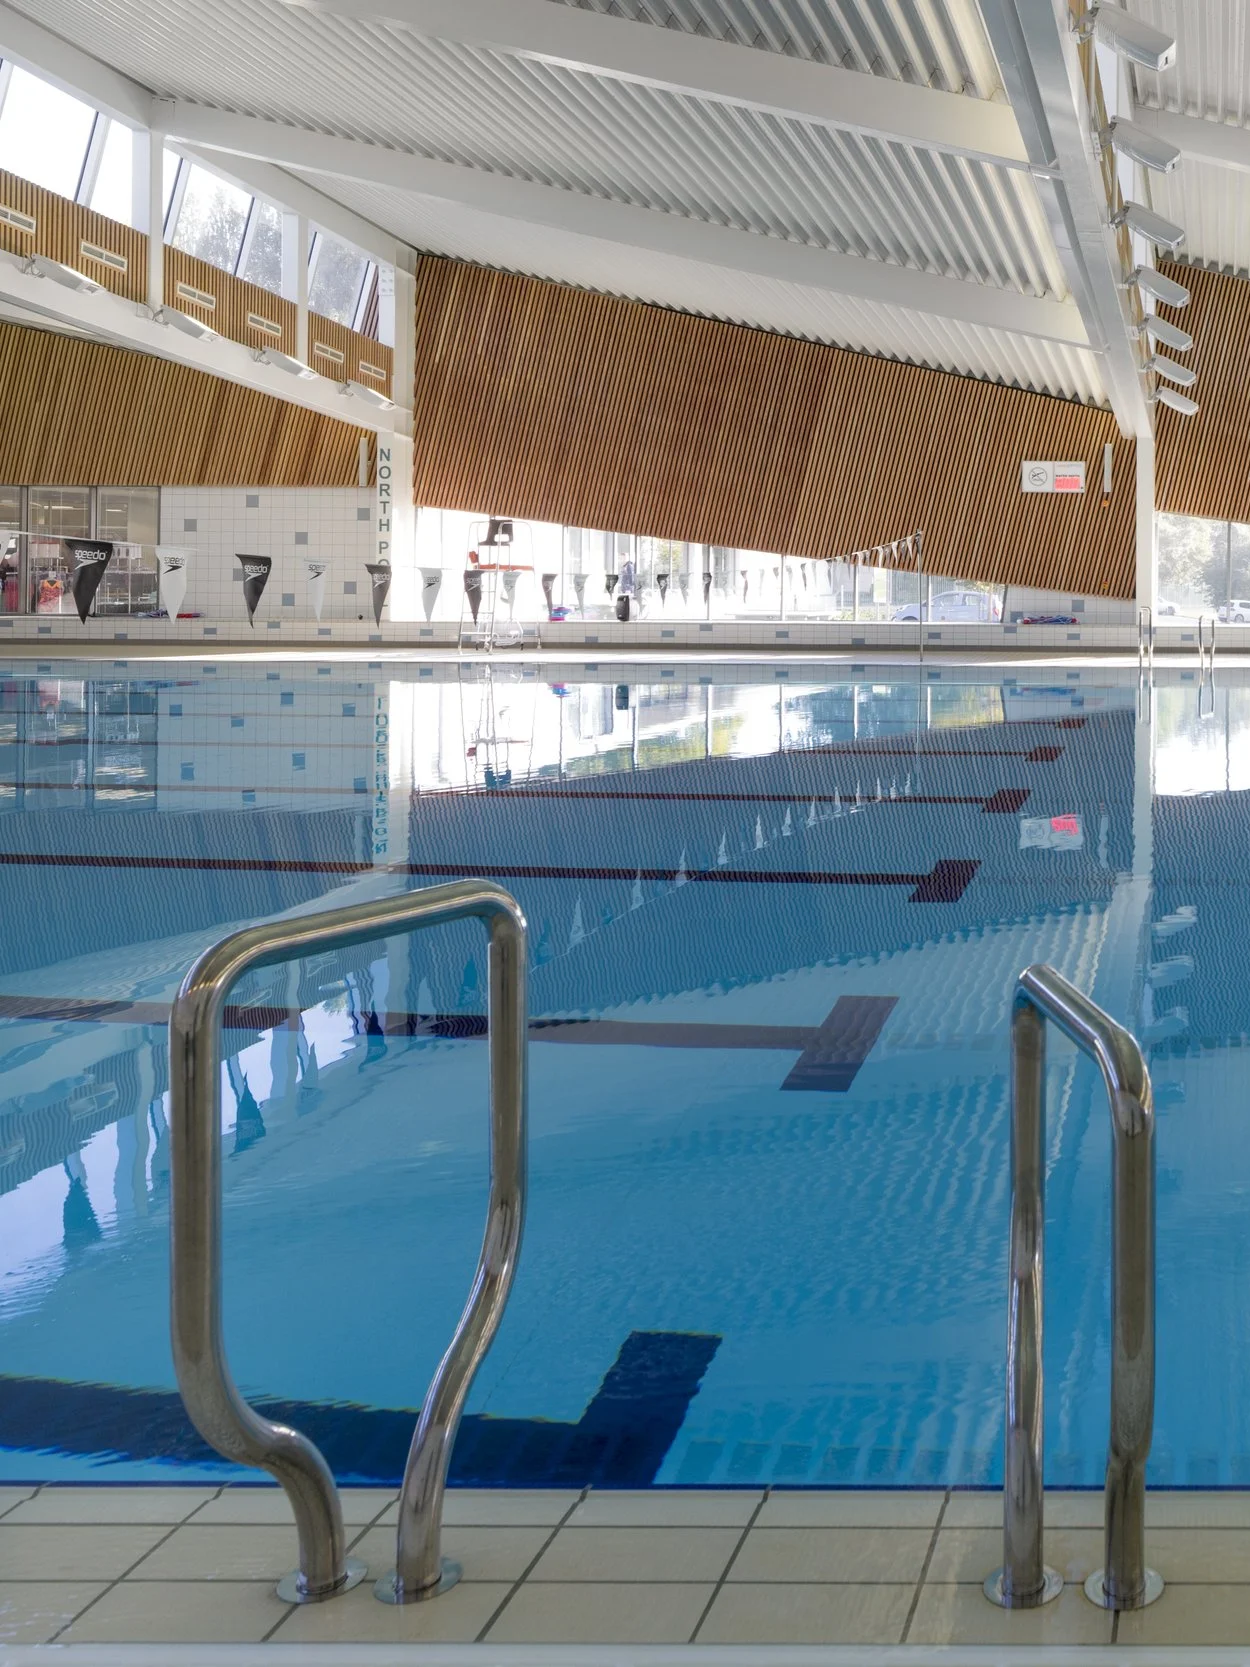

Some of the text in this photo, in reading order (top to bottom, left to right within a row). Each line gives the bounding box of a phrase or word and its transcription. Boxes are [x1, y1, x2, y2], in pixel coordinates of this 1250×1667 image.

[379, 448, 391, 531] NORTH
[75, 549, 106, 561] speedo
[244, 564, 268, 573] speedo
